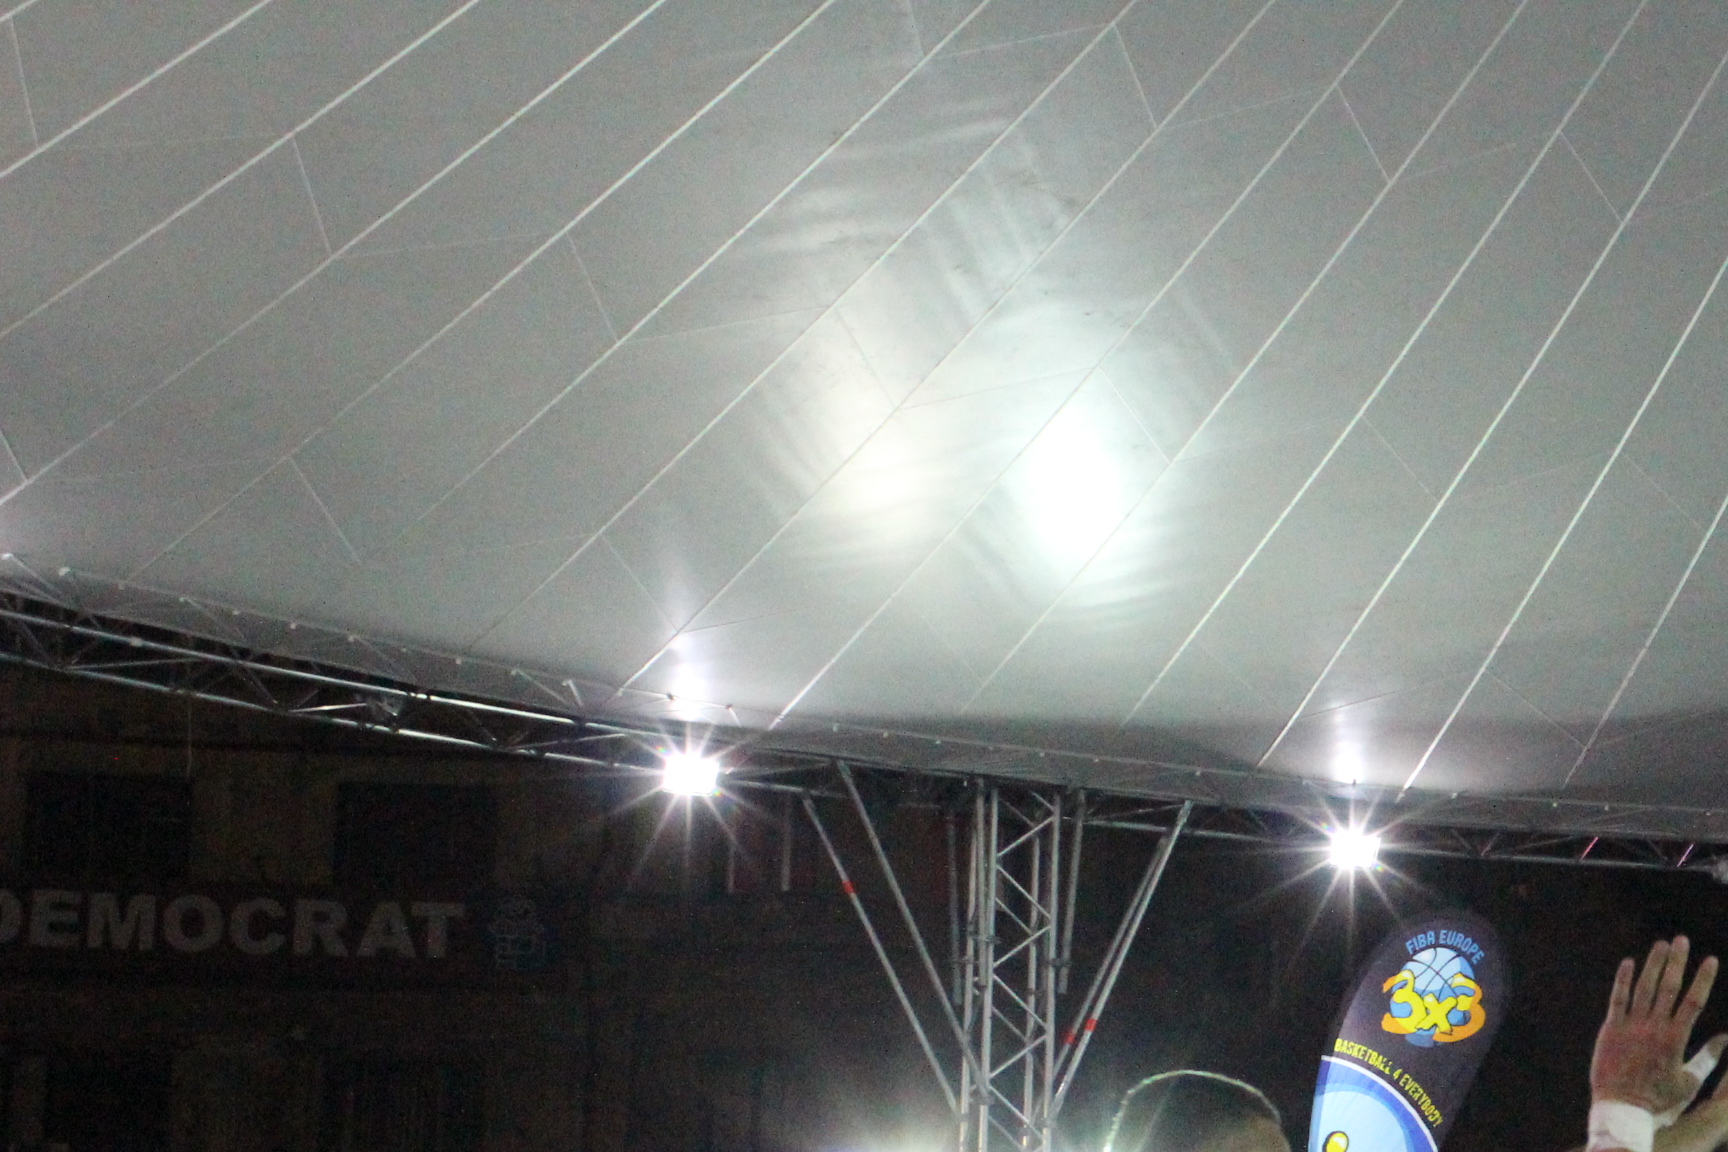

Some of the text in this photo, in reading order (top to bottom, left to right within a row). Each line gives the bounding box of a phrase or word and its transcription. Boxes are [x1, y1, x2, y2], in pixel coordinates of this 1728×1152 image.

[1405, 929, 1485, 965] FIBA EUROPE
[1334, 1038, 1443, 1128] BASKETBALL 4 EVERYBODY
